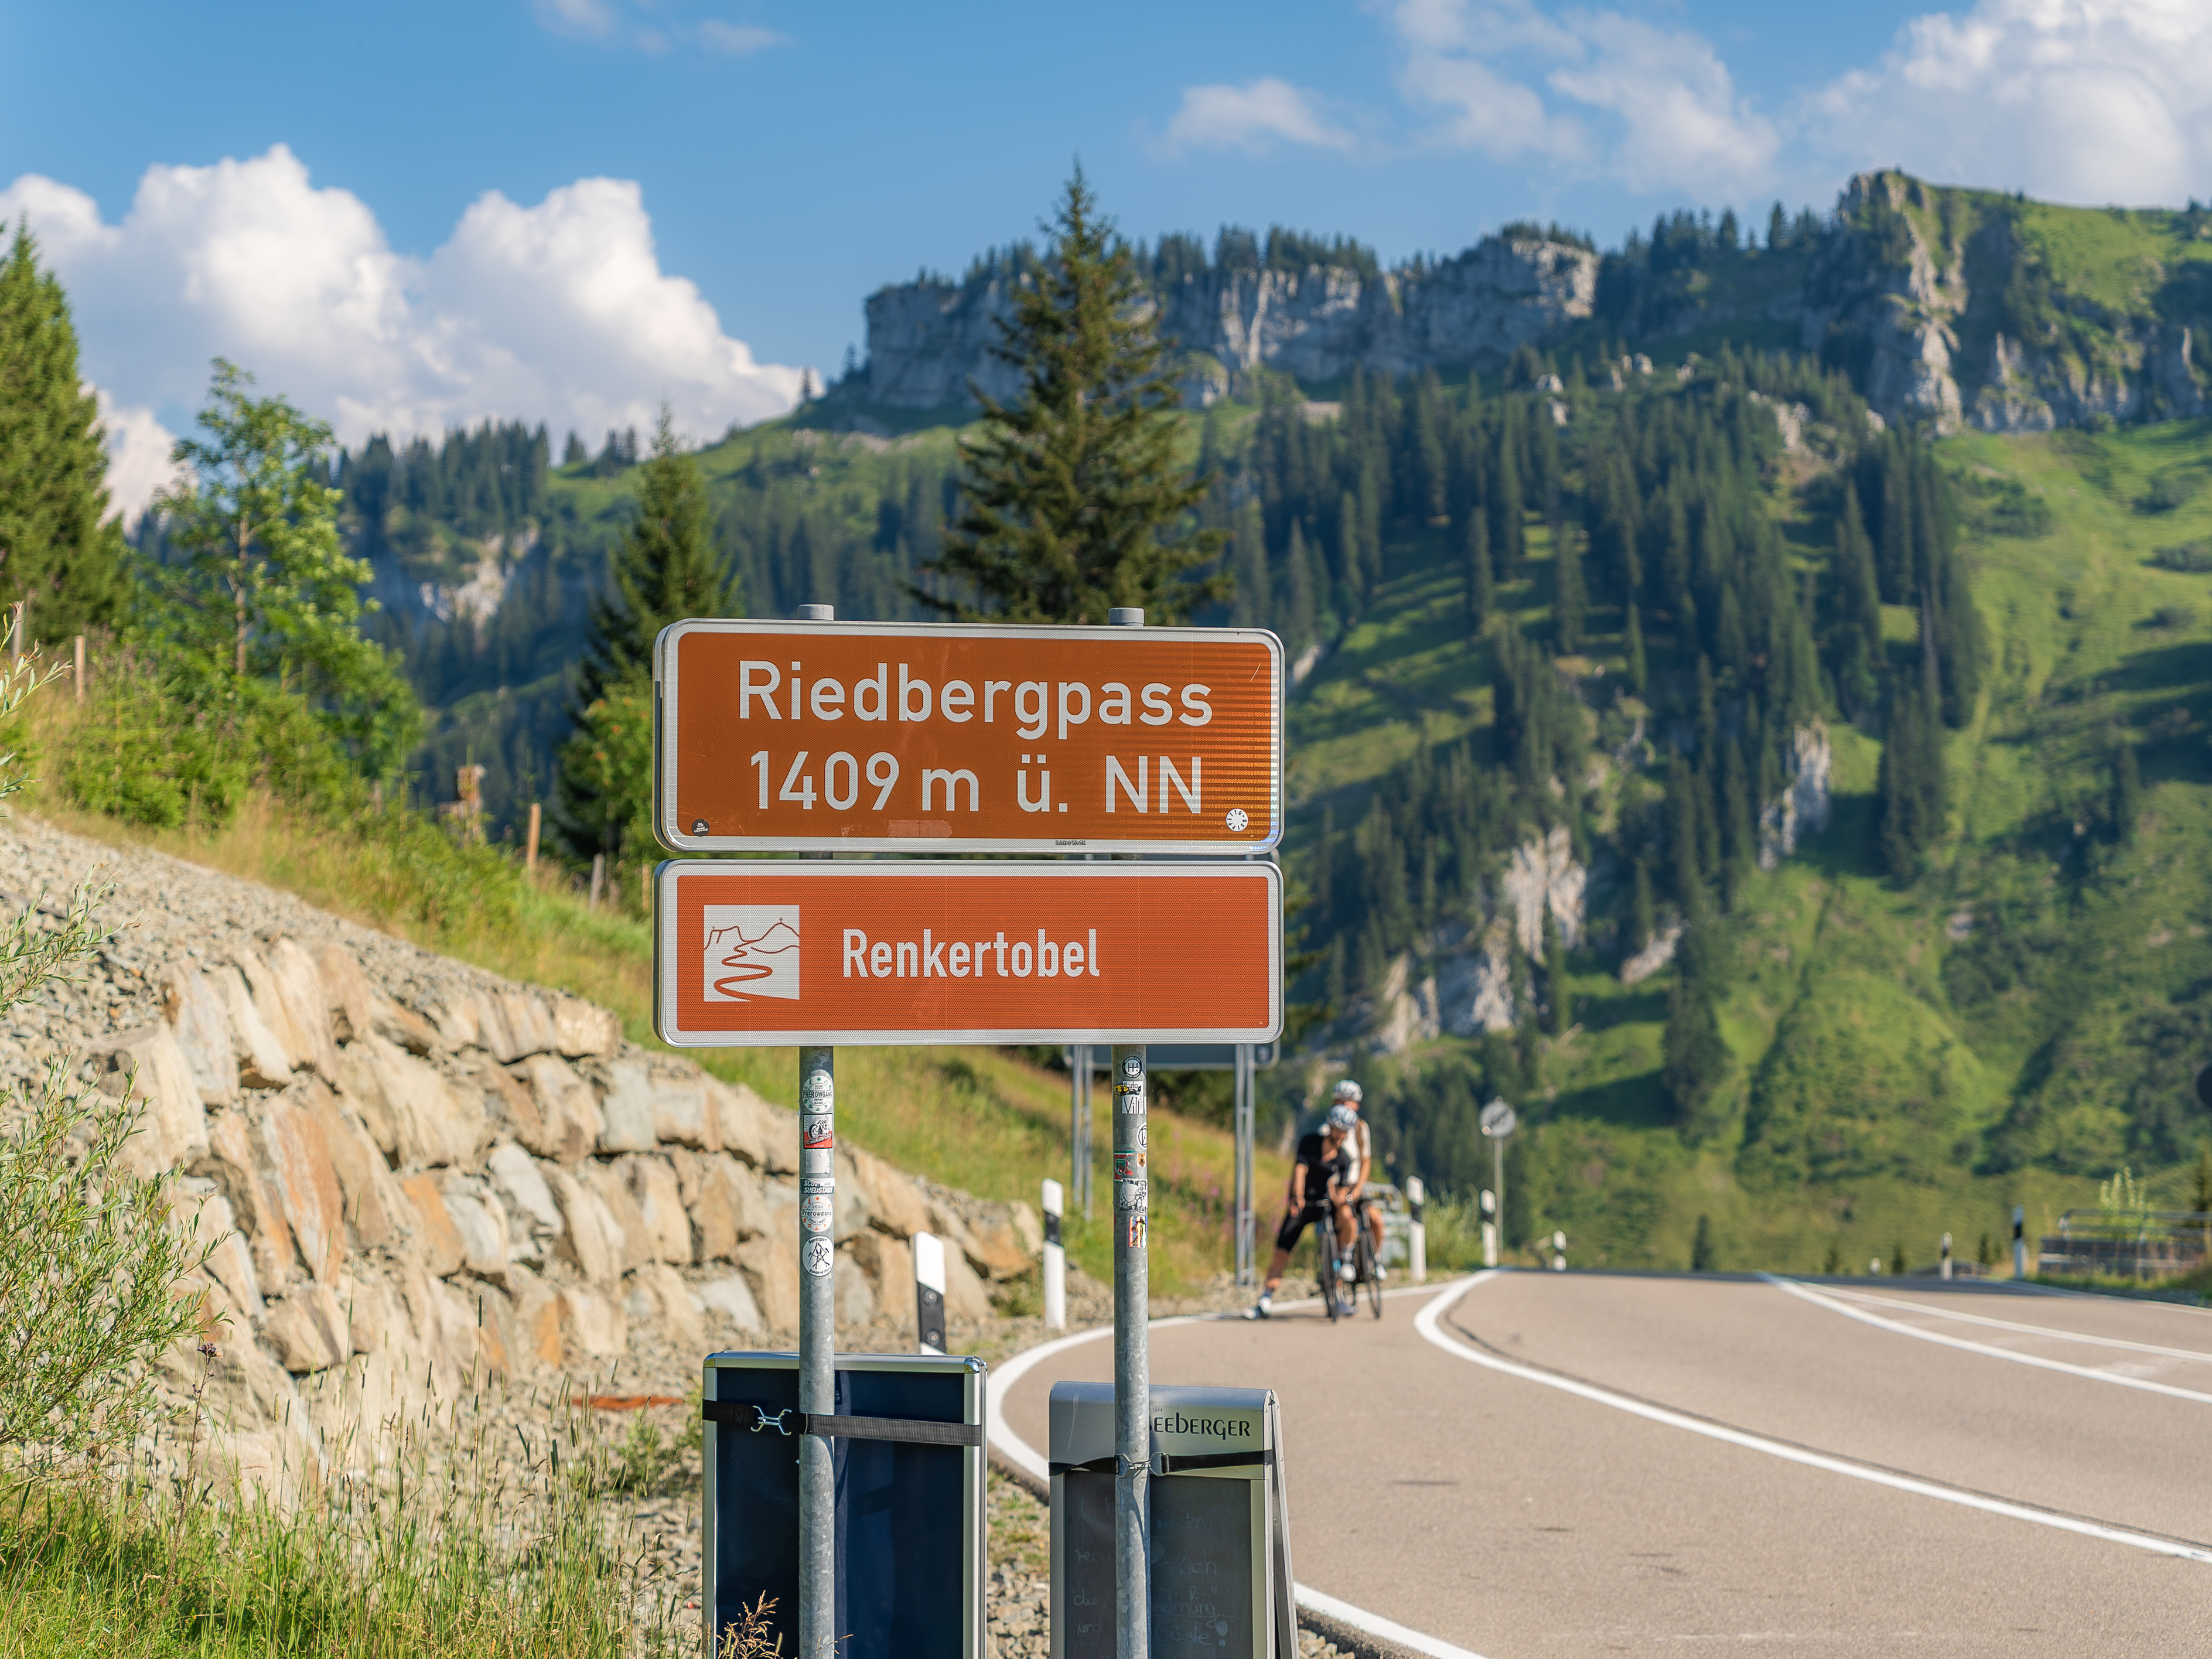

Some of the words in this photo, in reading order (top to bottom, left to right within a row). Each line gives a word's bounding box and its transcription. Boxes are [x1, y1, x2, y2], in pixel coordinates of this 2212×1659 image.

[739, 660, 1213, 740] Riedbergpass
[750, 750, 900, 811] 1409
[921, 767, 979, 811] m
[1016, 754, 1068, 813] ü.
[1105, 755, 1202, 815] NN
[842, 927, 1100, 978] Renkertobel
